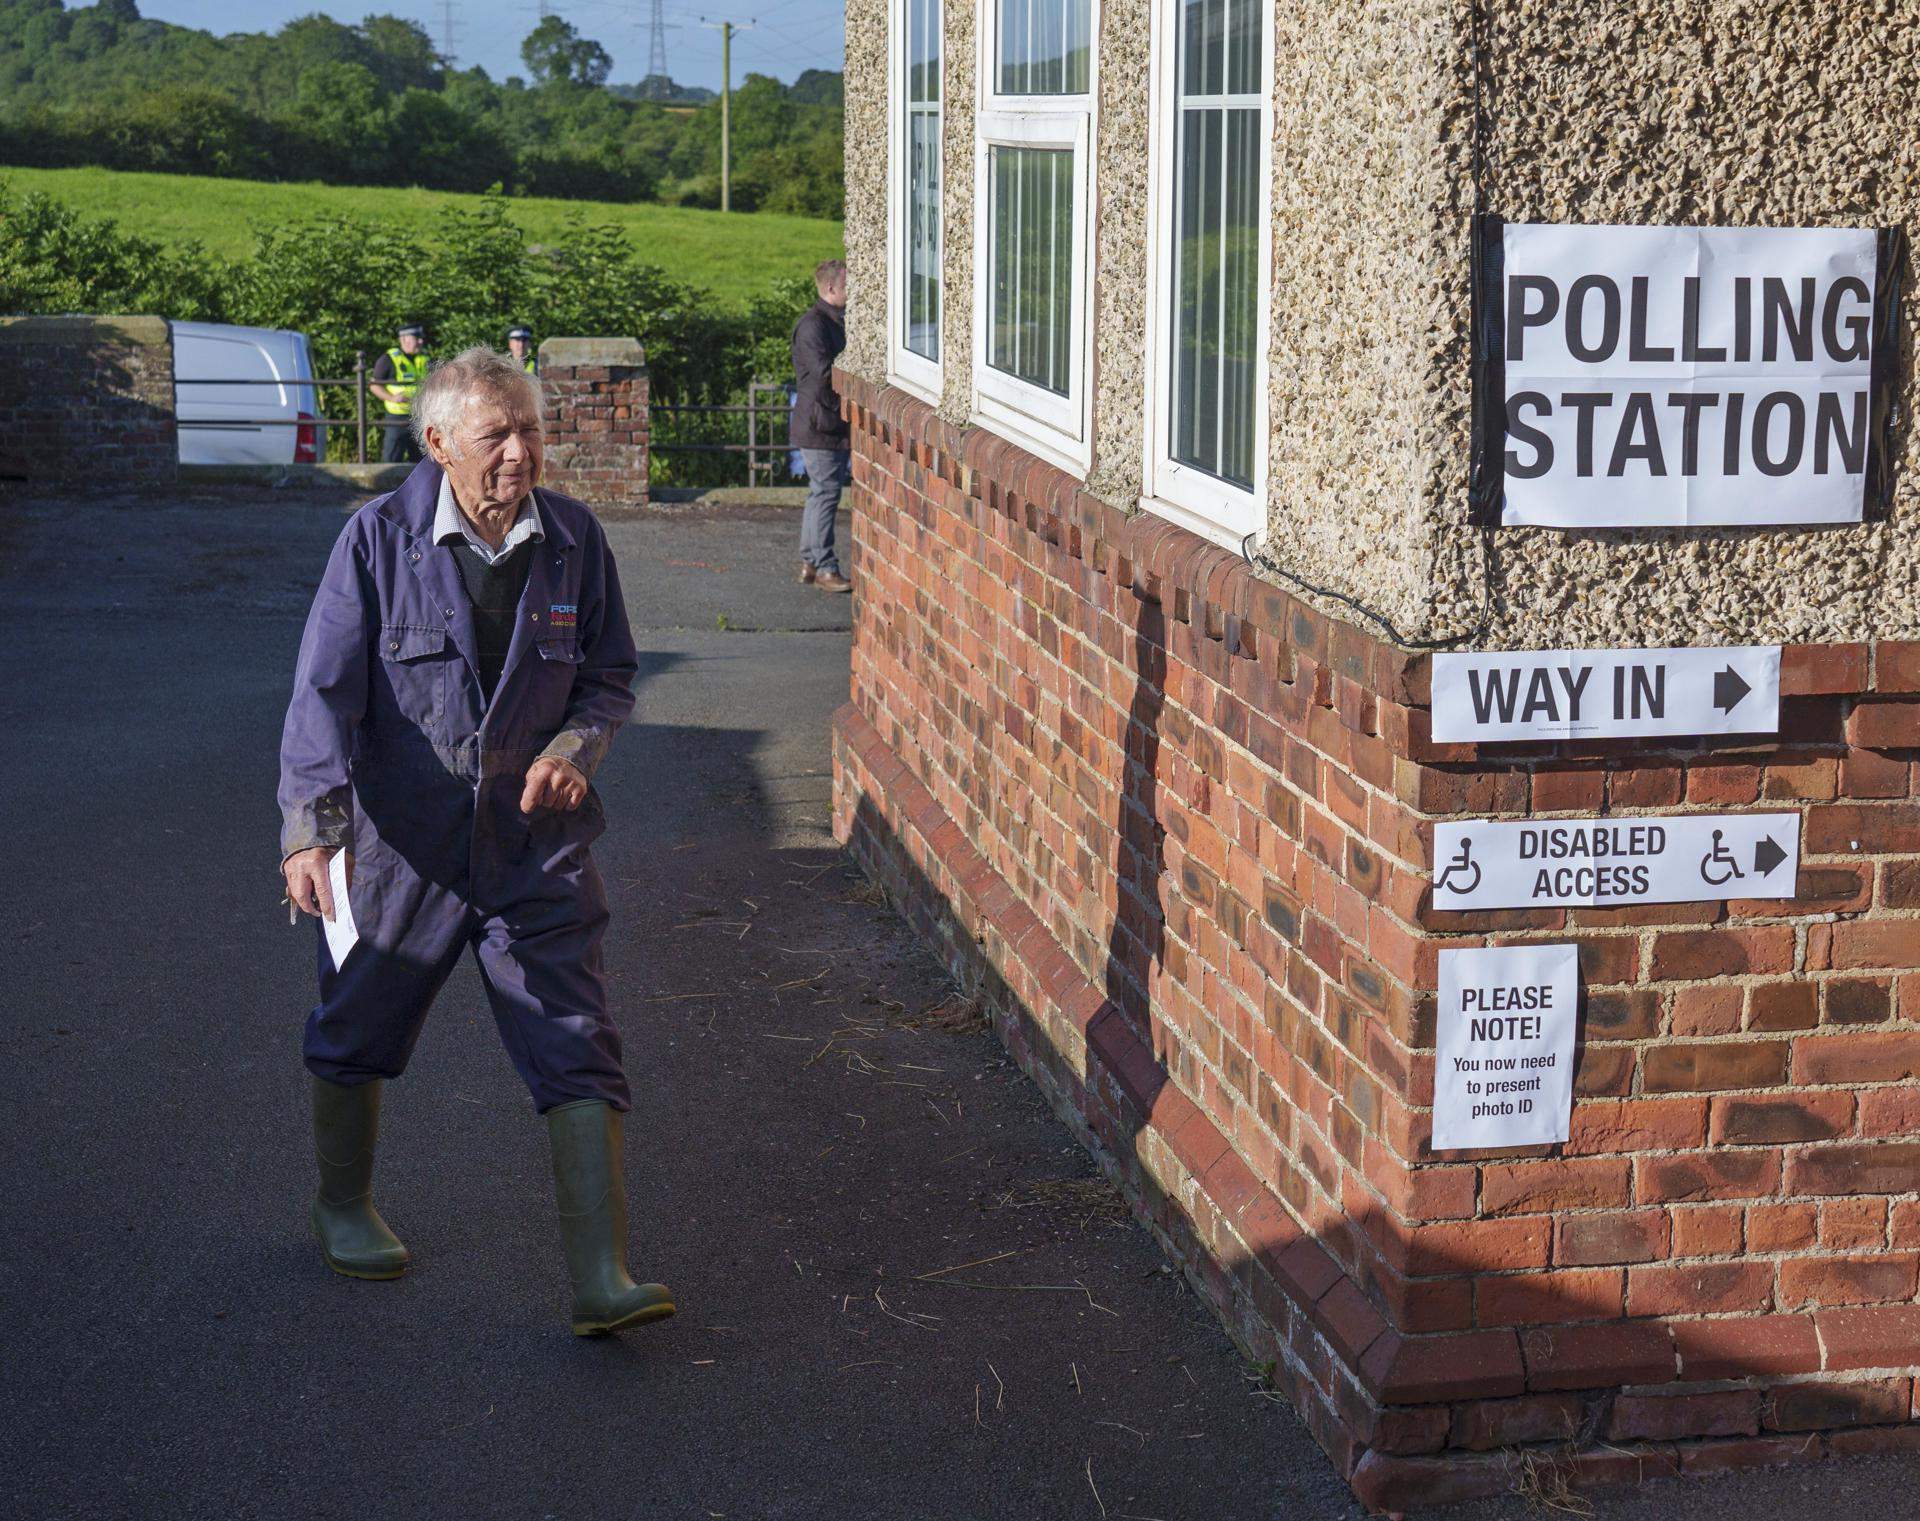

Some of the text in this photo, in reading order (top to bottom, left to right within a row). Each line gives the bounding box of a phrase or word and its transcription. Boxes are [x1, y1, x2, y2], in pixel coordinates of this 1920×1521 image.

[1506, 274, 1871, 363] POLLING
[1504, 391, 1866, 479] STATION
[1468, 665, 1665, 724] WAY IN
[1520, 826, 1665, 859] DISABLED
[1532, 866, 1649, 897] ACCESS
[1462, 986, 1552, 1011] PLEASE
[1471, 1017, 1540, 1041] NOTE!
[1454, 1053, 1555, 1071] You now need
[1467, 1077, 1541, 1096] to present
[1472, 1099, 1532, 1119] photo ID
